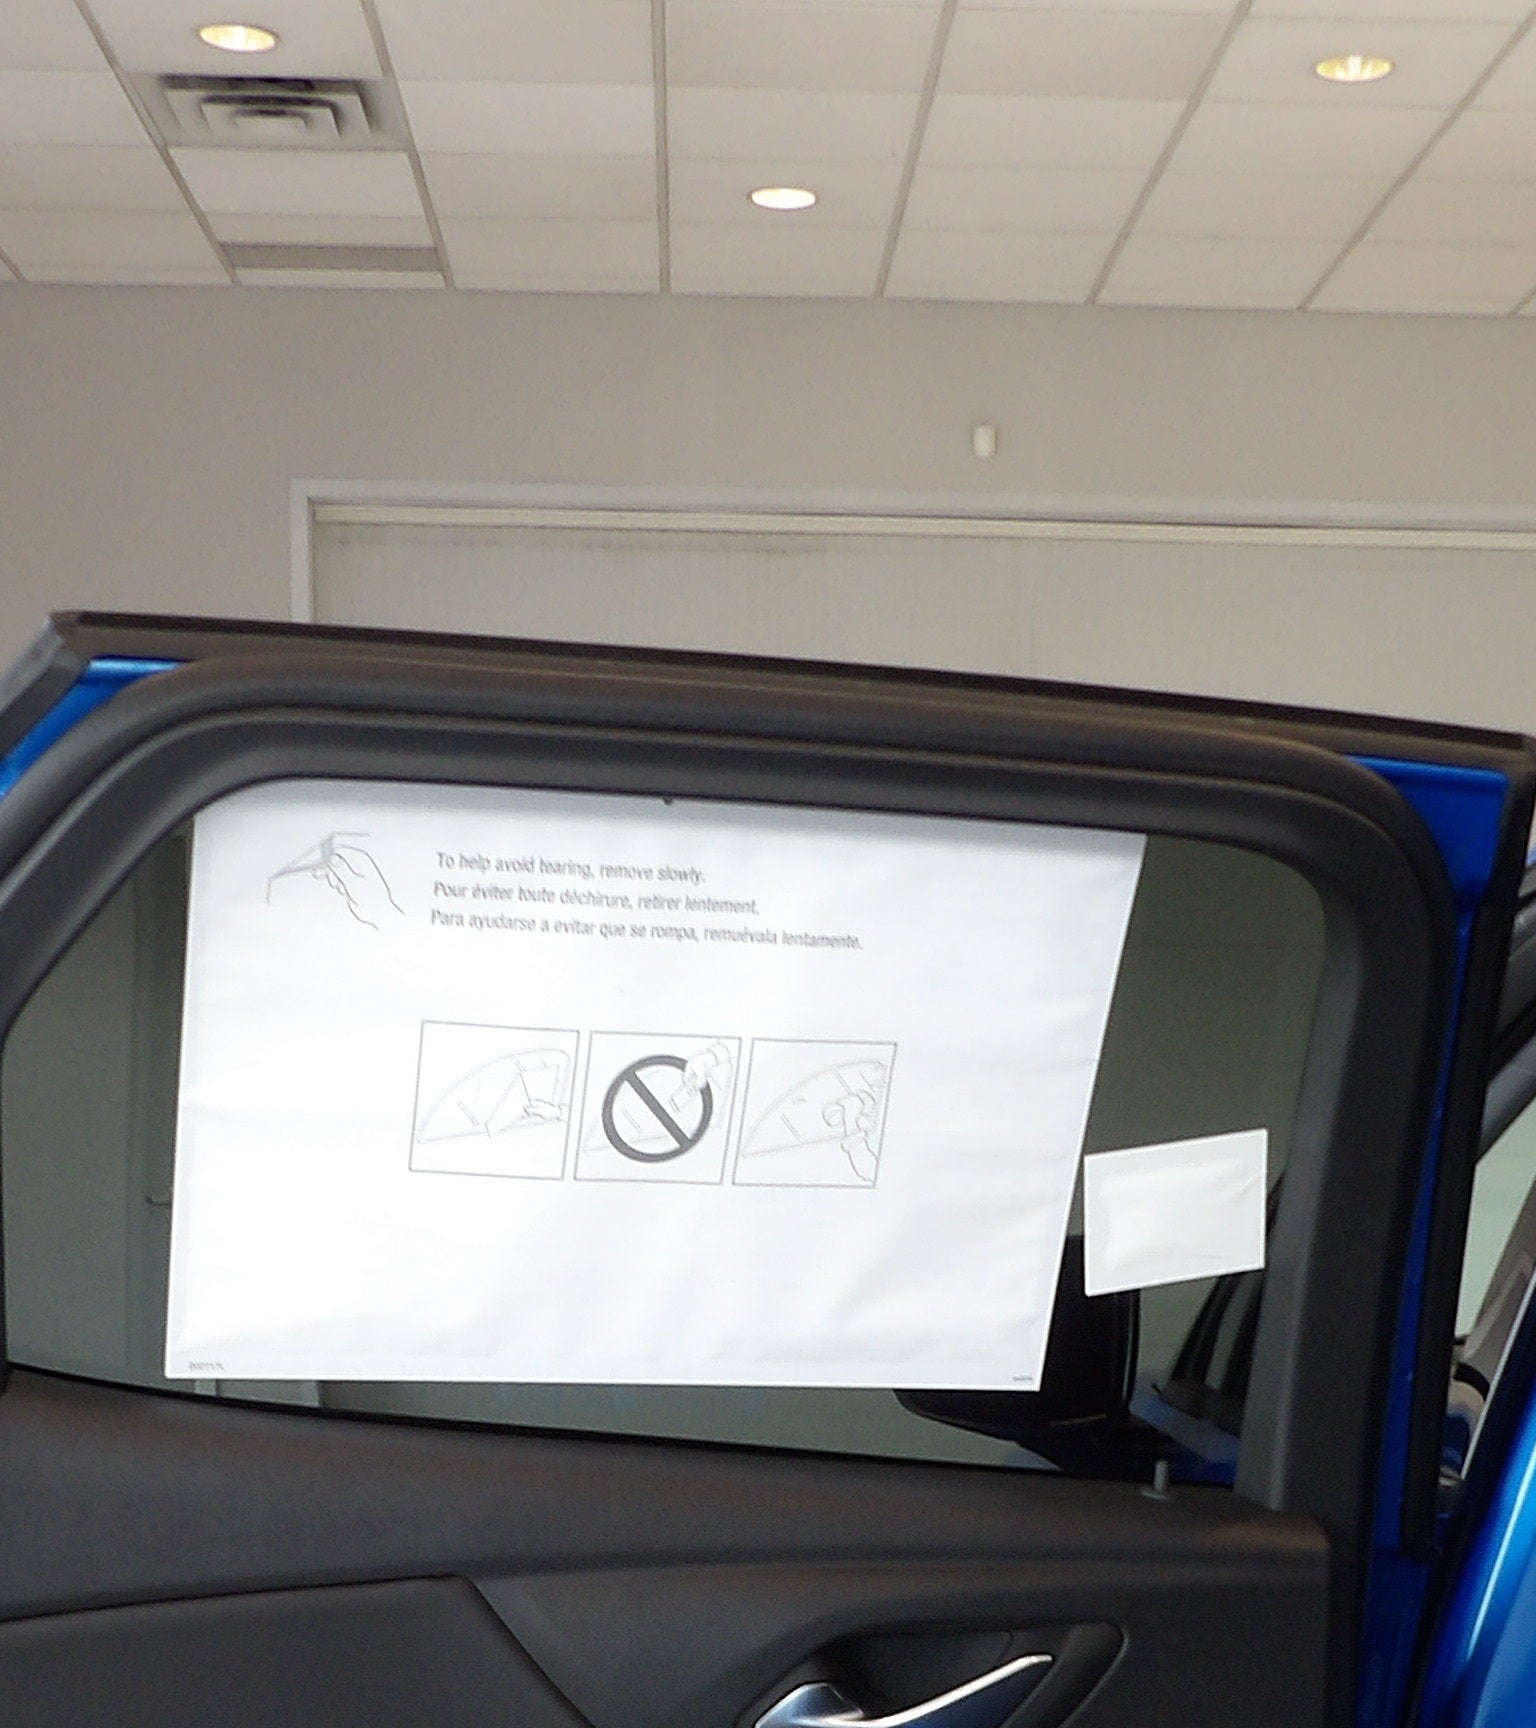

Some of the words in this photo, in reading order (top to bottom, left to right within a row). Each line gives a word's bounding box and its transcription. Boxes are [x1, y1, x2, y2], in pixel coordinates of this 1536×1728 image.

[437, 851, 455, 870] To
[458, 852, 491, 874] help
[495, 856, 534, 874] avoid
[539, 857, 594, 880] tearing,
[600, 863, 653, 880] remove
[657, 865, 706, 885] slowly.
[433, 881, 467, 898] Pour
[472, 883, 514, 901] éviter
[518, 886, 555, 903] toute
[559, 888, 633, 910] déchirure,
[638, 892, 681, 911] retirer
[685, 895, 759, 915] lentement.
[431, 909, 464, 926] Para
[468, 912, 536, 932] ayudarse
[540, 919, 550, 932] a
[554, 918, 596, 936] evitar
[599, 923, 625, 939] que
[630, 924, 647, 938] se
[650, 925, 699, 943] rompa,
[782, 929, 864, 949] lentamente.
